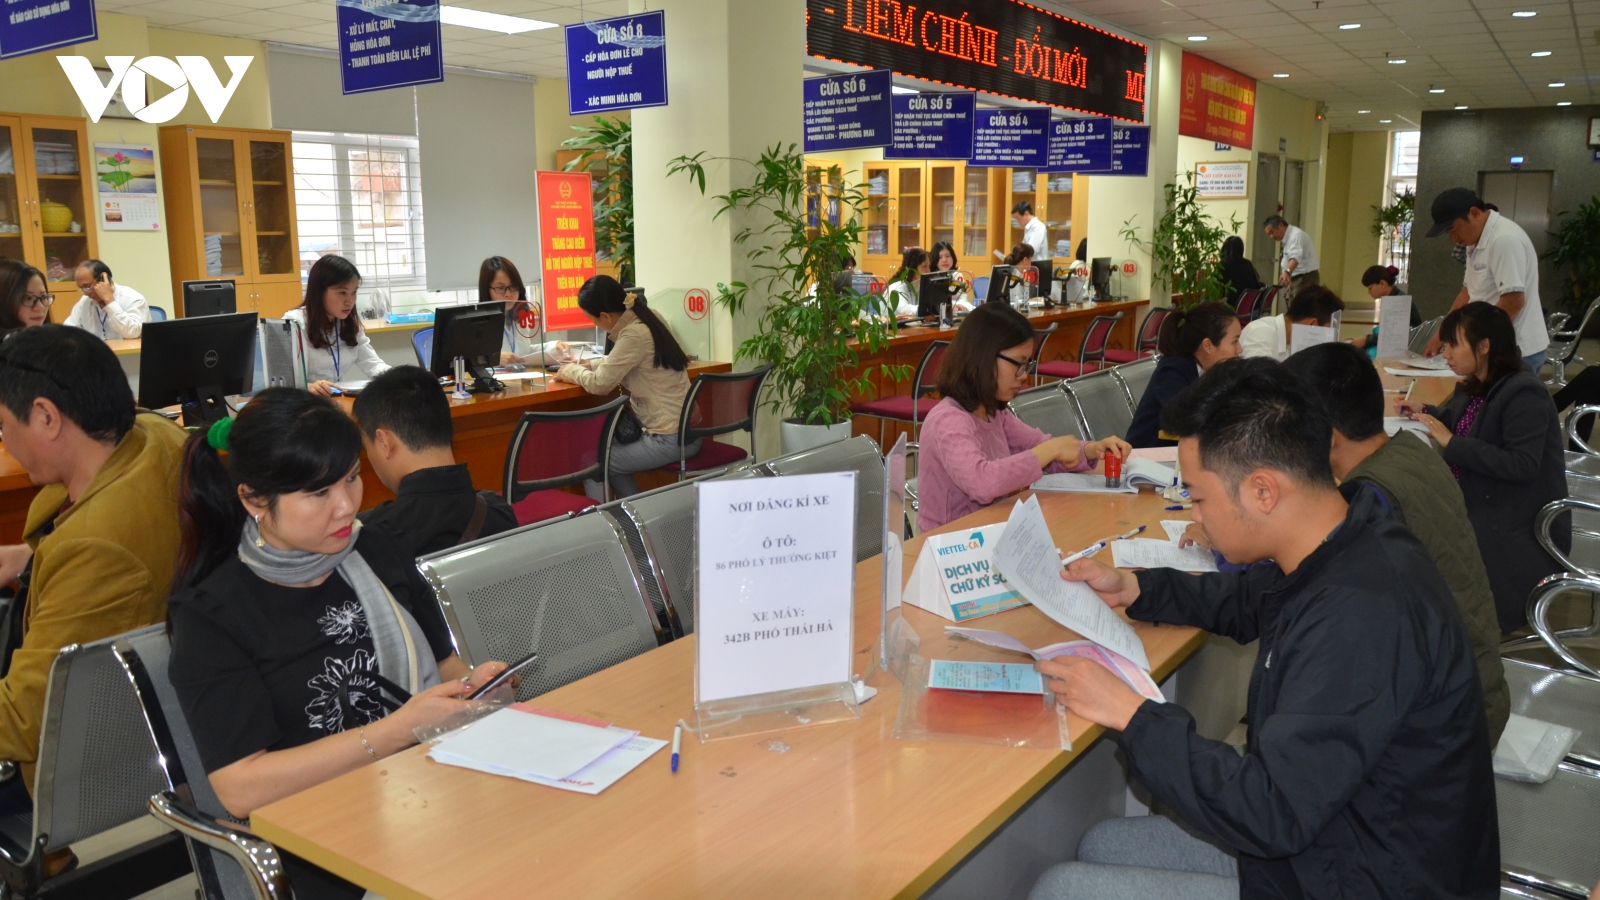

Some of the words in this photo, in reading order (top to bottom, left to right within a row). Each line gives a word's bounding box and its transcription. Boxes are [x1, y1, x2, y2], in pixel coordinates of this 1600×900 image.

[598, 24, 617, 44] CỬA
[620, 20, 634, 41] SỐ
[636, 24, 643, 38] 8
[350, 39, 365, 52] HỎNG
[366, 36, 378, 50] HÓA
[378, 36, 390, 48] ĐƠN
[921, 10, 998, 67] CHÍNH
[1014, 25, 1051, 80] ĐỔI
[1053, 46, 1087, 89] MỚI
[351, 56, 370, 68] THANH
[370, 52, 385, 66] TOÁN
[386, 50, 400, 62] BIÊN
[400, 49, 411, 60] LAI,
[412, 46, 420, 60] LỆ
[420, 42, 431, 56] PHÍ
[586, 51, 596, 63] CẤP
[598, 50, 609, 62] HÓA
[610, 50, 622, 60] ĐƠN
[623, 46, 630, 58] LẺ
[631, 47, 644, 57] CHO
[587, 68, 604, 80] NGƯỜI
[605, 66, 617, 79] NỘP
[618, 63, 632, 76] THUẾ
[820, 78, 840, 96] CỬA
[844, 76, 857, 94] SỐ
[859, 78, 866, 92] 6
[588, 96, 600, 106] XÁC
[601, 94, 616, 106] MINH
[617, 92, 628, 103] HÓA
[630, 92, 642, 102] ĐƠN
[908, 95, 928, 110] CỬA
[930, 94, 943, 110] SỐ
[946, 98, 952, 110] 5
[990, 111, 1007, 126] CỬA
[1010, 112, 1021, 126] SỐ
[1022, 116, 1028, 126] 4
[1056, 122, 1072, 134] CỬA
[1074, 121, 1085, 133] SỐ
[1088, 124, 1093, 132] 3
[1113, 129, 1124, 140] SỐ
[1125, 131, 1130, 140] 2
[556, 212, 568, 230] TRIỂN
[569, 218, 578, 230] KHAI
[552, 235, 566, 250] THÁNG
[566, 237, 574, 249] CAO
[575, 232, 585, 249] ĐIỂM
[546, 254, 552, 270] HỖ
[552, 256, 560, 272] TRỢ
[561, 254, 574, 269] NGƯỜI
[574, 254, 582, 271] NỘP
[582, 253, 592, 268] THUẾ
[1124, 263, 1134, 272] 03
[1024, 271, 1034, 282] 05
[1077, 267, 1088, 277] 04
[557, 274, 568, 289] TRÊN
[576, 274, 584, 288] BÀN
[557, 294, 568, 311] QUẬN
[688, 296, 704, 312] 08
[519, 310, 536, 329] 09
[729, 501, 752, 514] NƠI
[757, 498, 793, 512] ĐĂNG
[796, 494, 810, 507] KÍ
[813, 495, 830, 506] XE
[762, 535, 773, 549] Ô
[777, 534, 797, 548] TÔ:
[937, 541, 979, 556] VIETTEL-CA
[716, 562, 726, 570] 86
[752, 556, 767, 567] LÝ
[814, 550, 838, 562] KIỆT
[944, 566, 972, 580] DỊCH
[973, 560, 990, 573] VỤ
[950, 578, 974, 594] CHỮ
[976, 574, 990, 588] KÝ
[752, 612, 769, 622] XE
[773, 606, 805, 620] MÁY:
[724, 633, 750, 644] 342B
[754, 628, 780, 641] PHỐ
[784, 624, 813, 636] THÁI
[817, 619, 834, 633] HÀ
